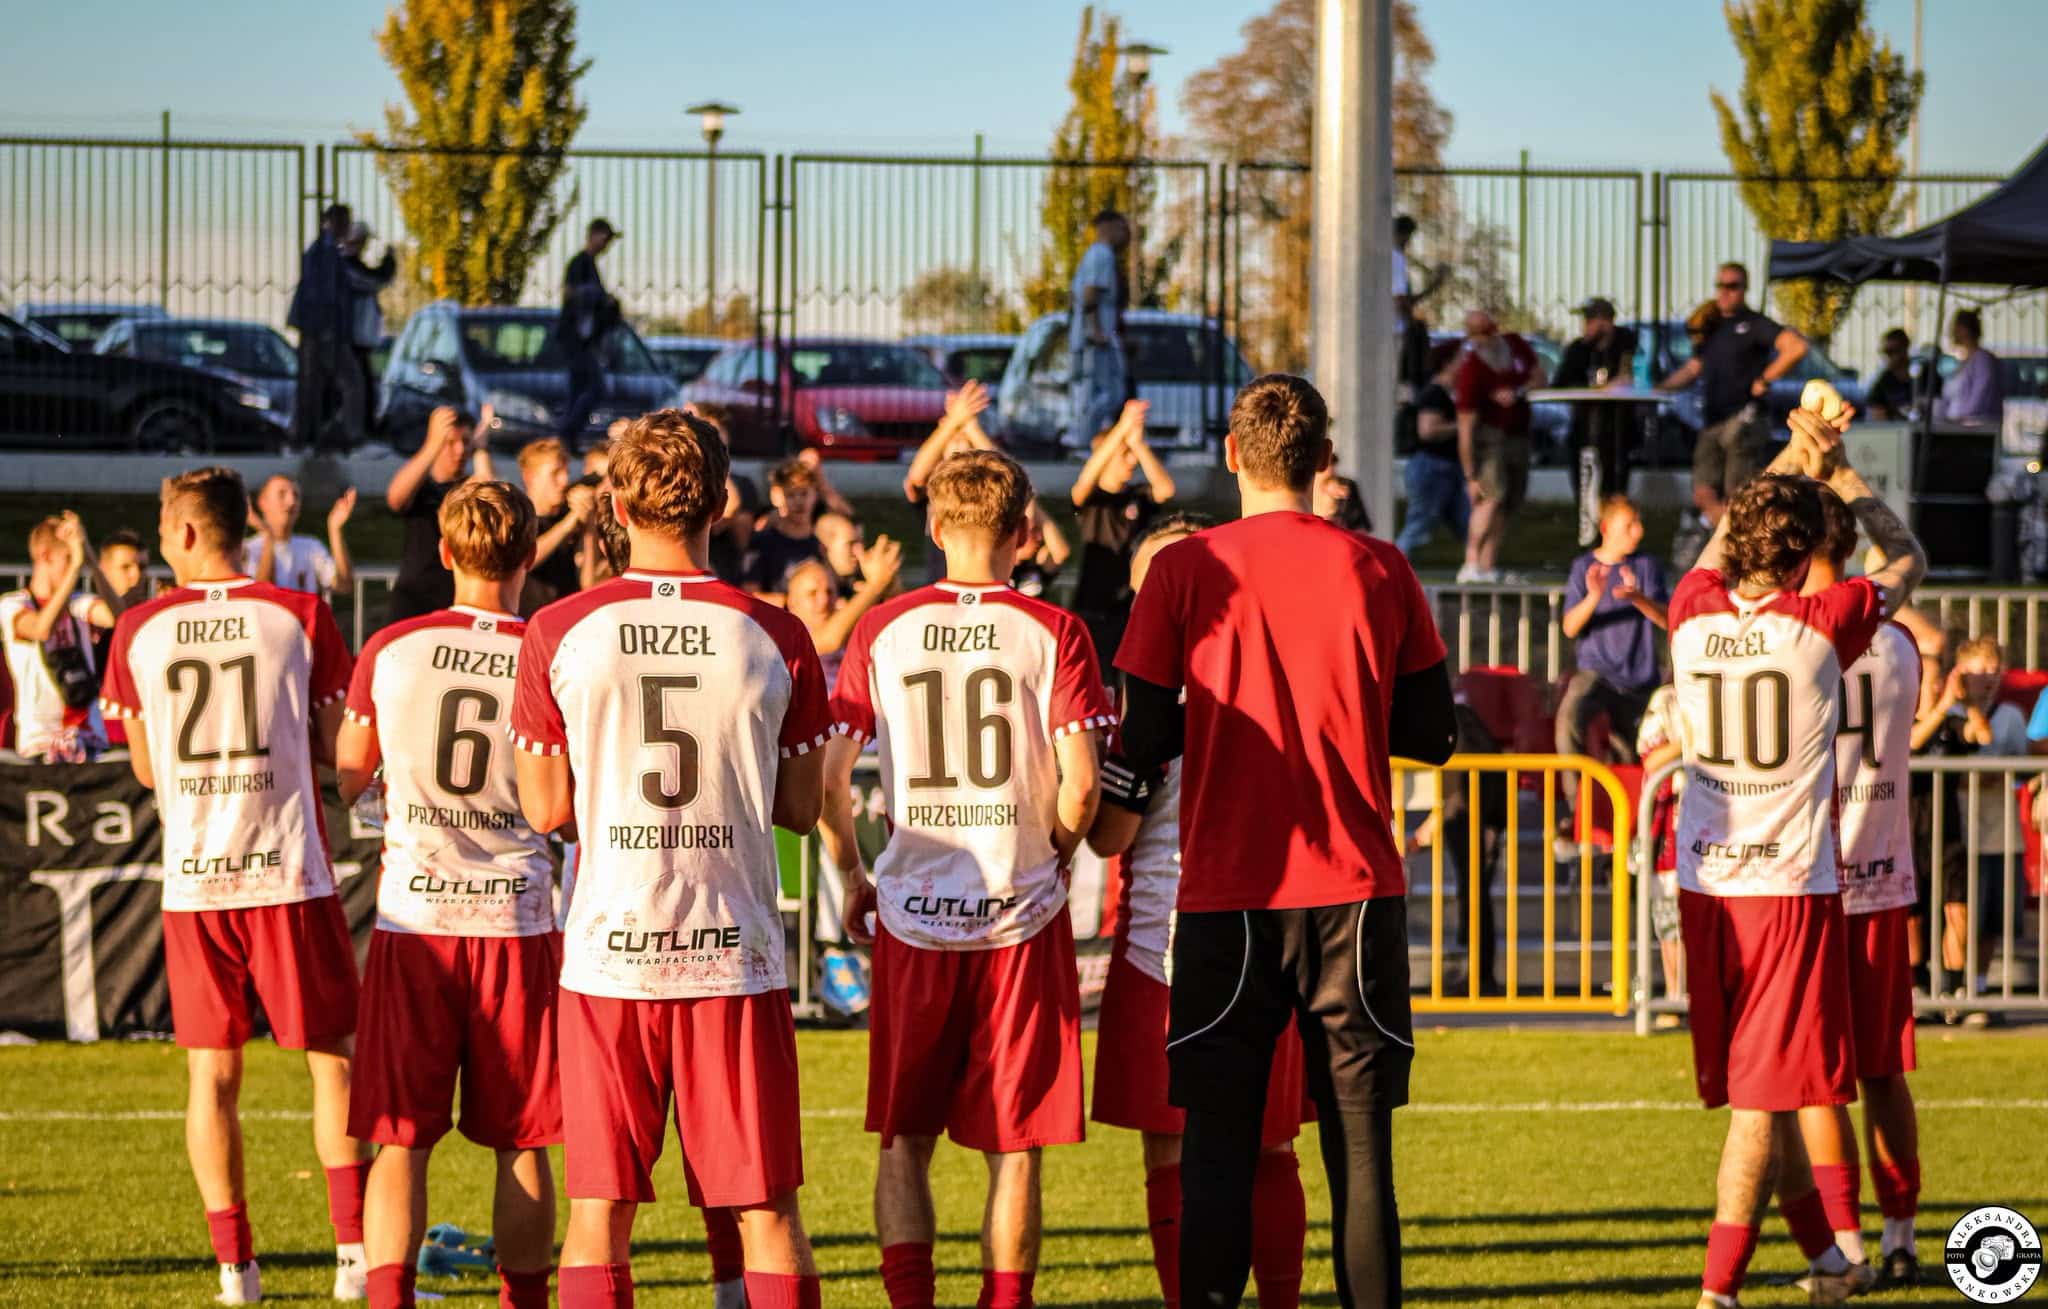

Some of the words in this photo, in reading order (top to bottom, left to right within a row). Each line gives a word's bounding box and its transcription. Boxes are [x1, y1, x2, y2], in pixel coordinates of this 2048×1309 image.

[177, 616, 249, 645] ORZEŁ
[619, 623, 717, 656] ORZEŁ
[923, 623, 1000, 653] ORZEŁ
[166, 655, 270, 762] 21
[1692, 669, 1790, 770] 10
[436, 688, 499, 795] 6
[641, 675, 699, 808] 5
[903, 667, 1012, 788] 16
[182, 850, 281, 875] CUTLINE
[408, 875, 528, 895] CUTLINE
[607, 926, 741, 953] CUTLINE
